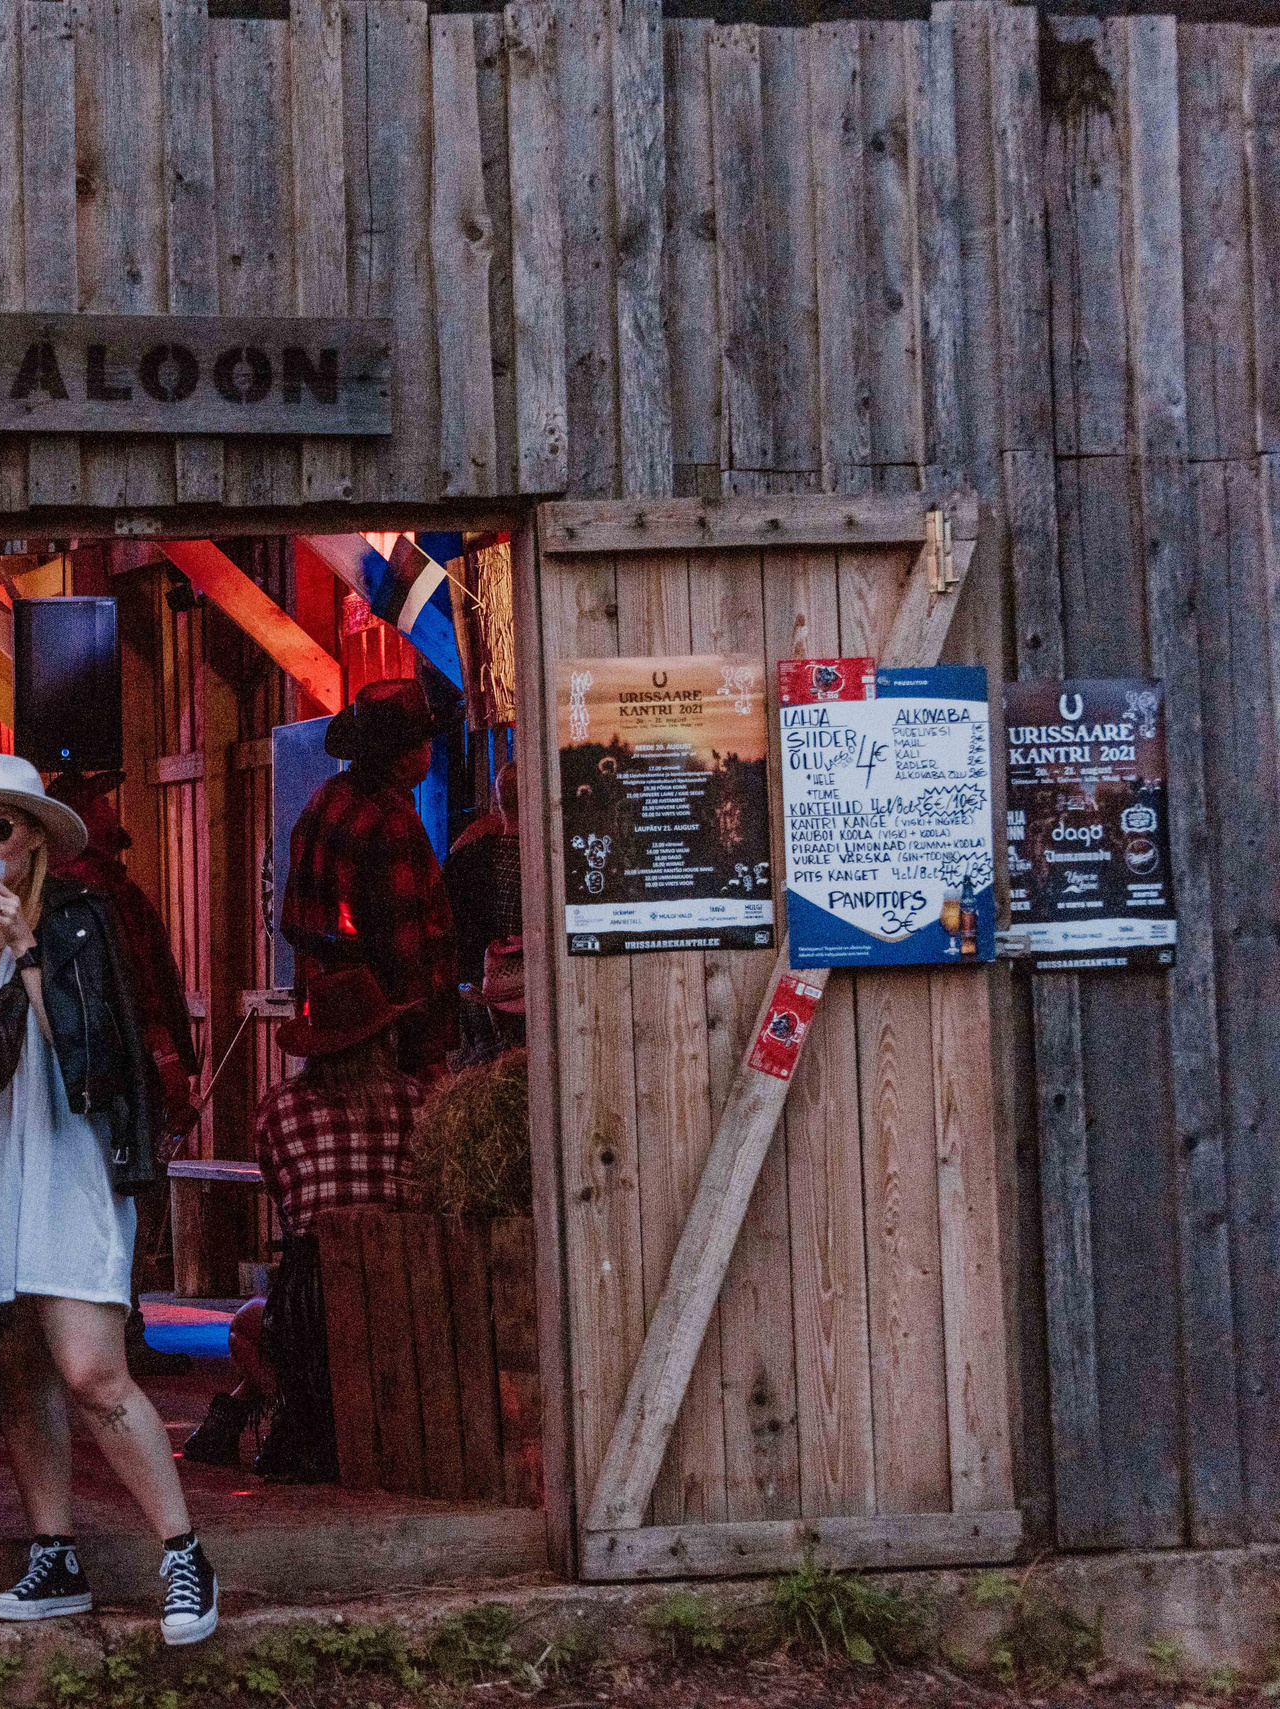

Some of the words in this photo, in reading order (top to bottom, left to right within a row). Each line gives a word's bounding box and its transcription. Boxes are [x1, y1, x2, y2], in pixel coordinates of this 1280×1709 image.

[619, 690, 703, 704] URISSAARE
[619, 704, 673, 717] KANTRI
[679, 703, 703, 714] 2021
[895, 708, 971, 725] ALKOVABA
[787, 729, 857, 749] SIIDER
[892, 727, 951, 738] PUDELIVESI
[1008, 724, 1136, 745] URISSAARE
[894, 739, 926, 748] MAHL
[970, 735, 986, 744] 2€
[789, 748, 824, 770] ÕLU
[895, 749, 920, 760] KALI
[968, 744, 986, 754] 2€
[1008, 746, 1091, 765] KANTRI
[1099, 745, 1136, 762] 2021
[856, 734, 890, 789] 4€
[895, 760, 939, 770] RADLER
[967, 755, 987, 766] 2€
[895, 770, 946, 780] ALKOVABA
[968, 767, 988, 778] 2€
[1080, 766, 1113, 776] august
[789, 800, 863, 816] KOKTEILID
[634, 825, 662, 833] LAUPÄEV
[791, 817, 837, 830] KANTRI
[843, 815, 887, 829] KANGE
[791, 829, 833, 842] KAUBOI
[840, 829, 873, 840] KOOLA
[791, 843, 840, 854] PIRAADI
[844, 841, 906, 853] LIMONAAD
[792, 854, 831, 865] VURLE
[794, 870, 823, 883] PITS
[828, 868, 880, 881] KANGET
[827, 890, 927, 911] PANDITOPS
[880, 910, 922, 935] 3€
